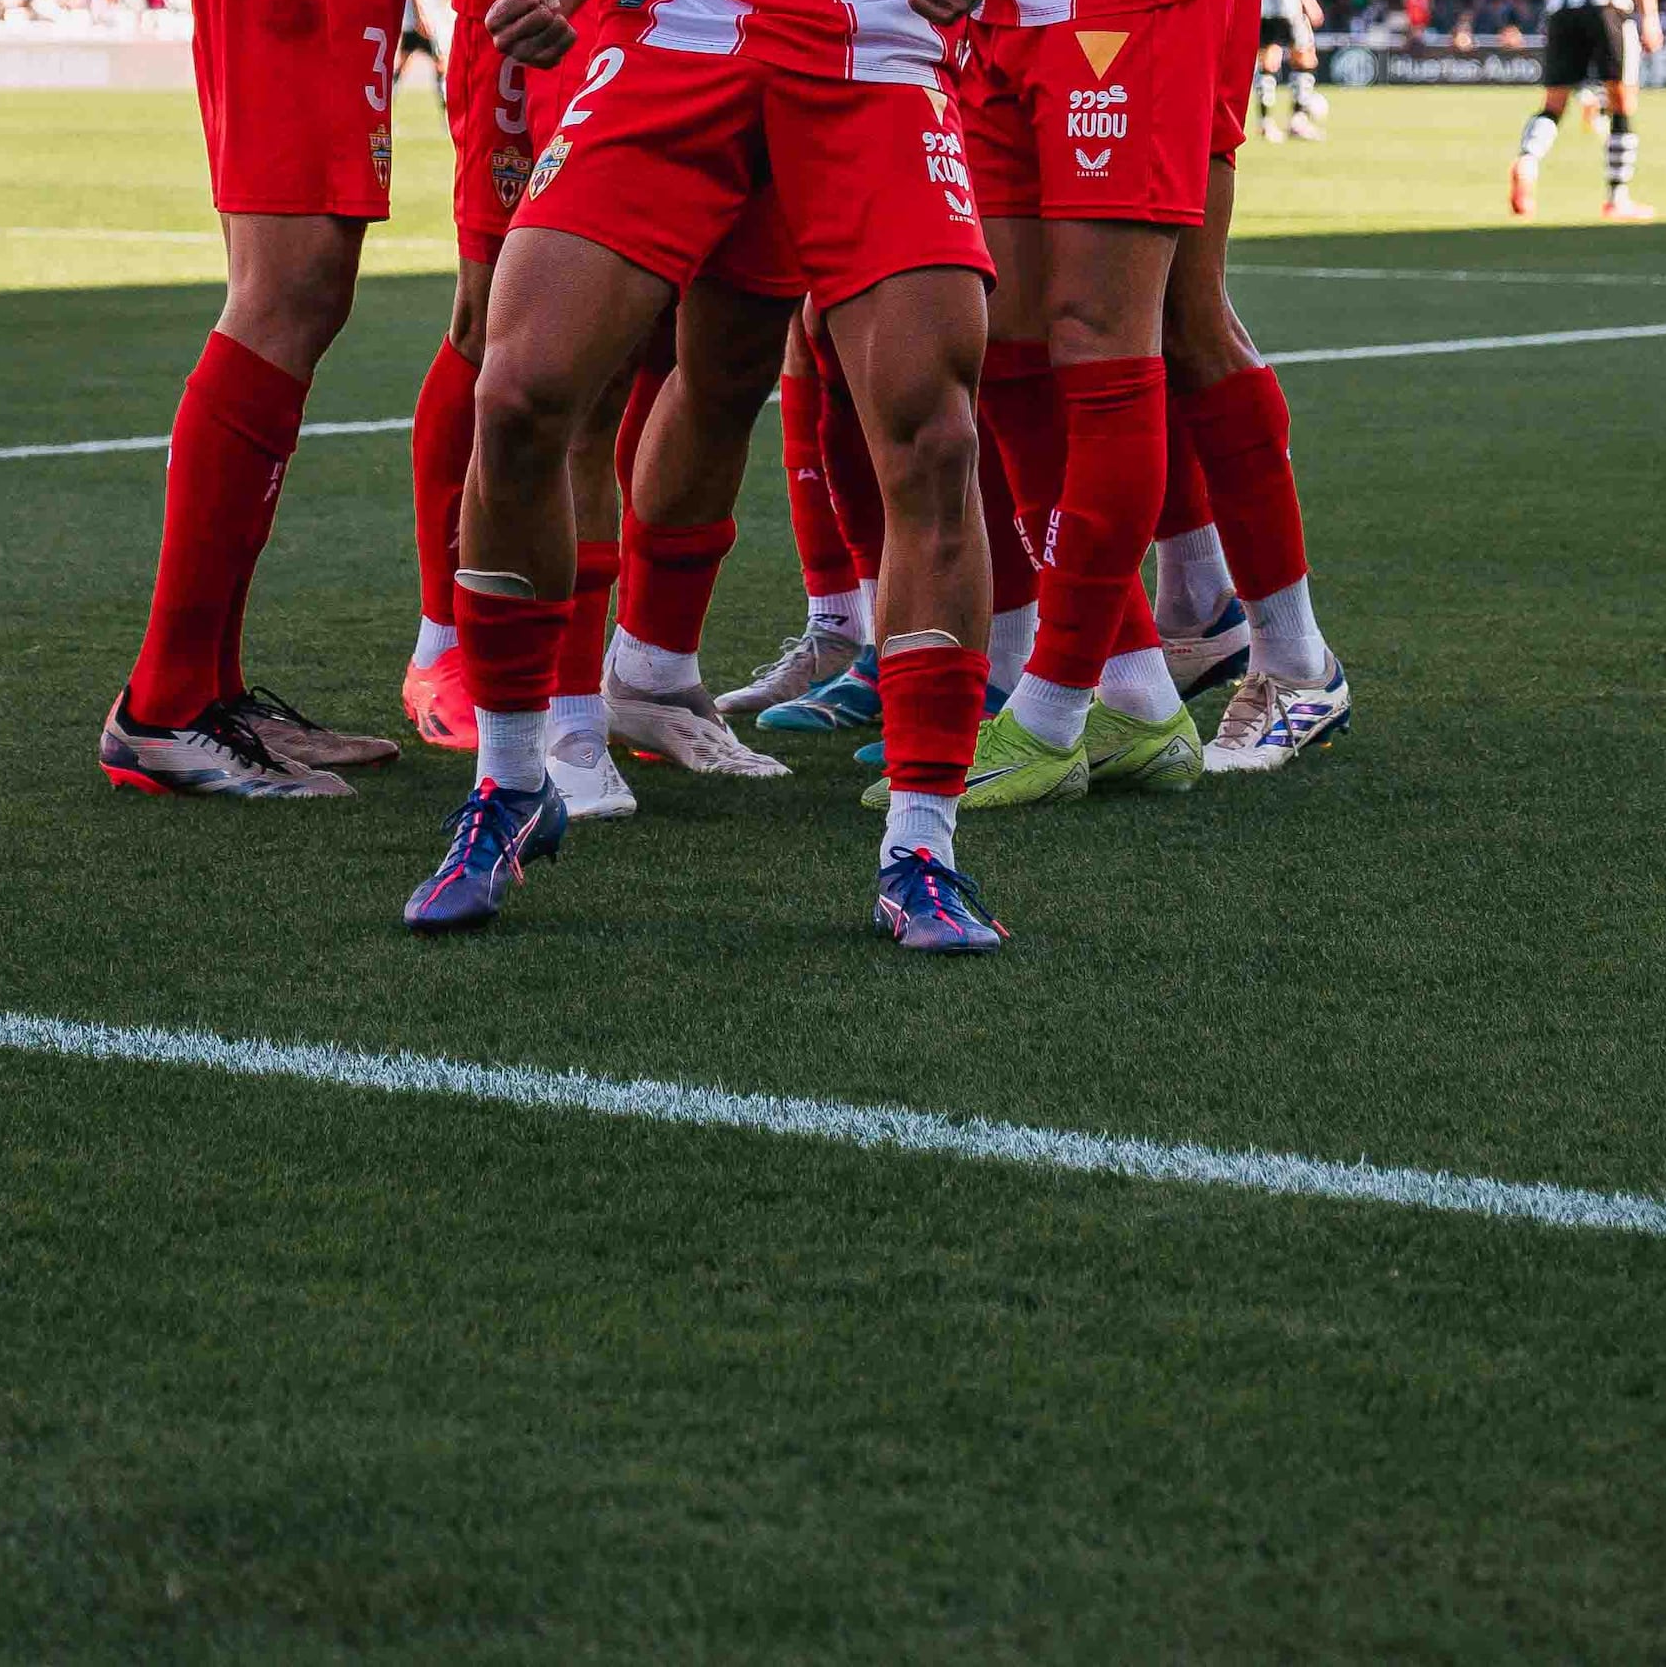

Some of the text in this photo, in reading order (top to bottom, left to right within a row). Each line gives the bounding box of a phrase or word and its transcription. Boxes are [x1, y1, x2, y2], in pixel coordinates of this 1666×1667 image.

[363, 26, 388, 112] 3
[561, 47, 625, 128] 2
[1067, 112, 1128, 138] KUDU
